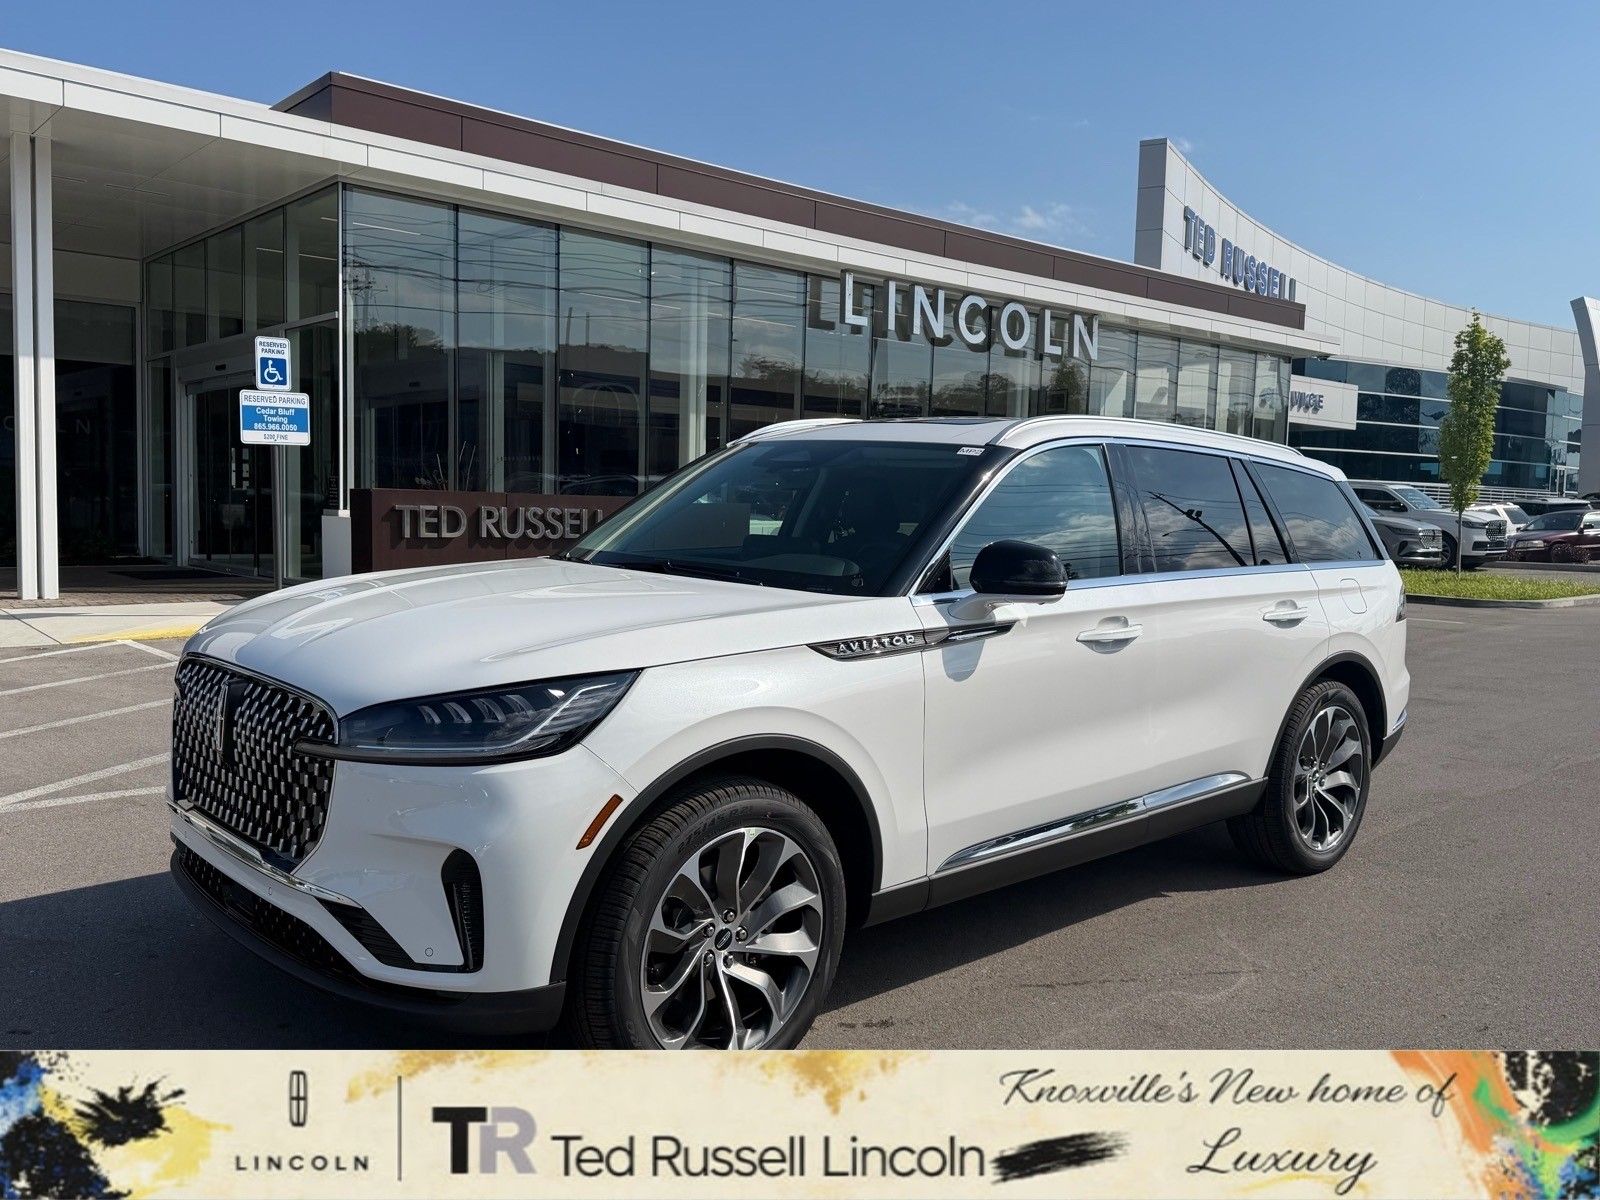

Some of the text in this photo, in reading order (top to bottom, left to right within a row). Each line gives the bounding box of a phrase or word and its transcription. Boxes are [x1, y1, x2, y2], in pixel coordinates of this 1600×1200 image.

[1184, 205, 1216, 267] TED
[841, 270, 1099, 361] LINCOLN
[259, 341, 287, 349] RESERVED
[262, 347, 285, 355] PARKING
[243, 394, 306, 405] RESERVED PARKING
[255, 407, 295, 416] Cedar Bluff
[263, 414, 288, 424] Towing
[395, 504, 468, 539] TED
[836, 634, 916, 655] AVIATOR
